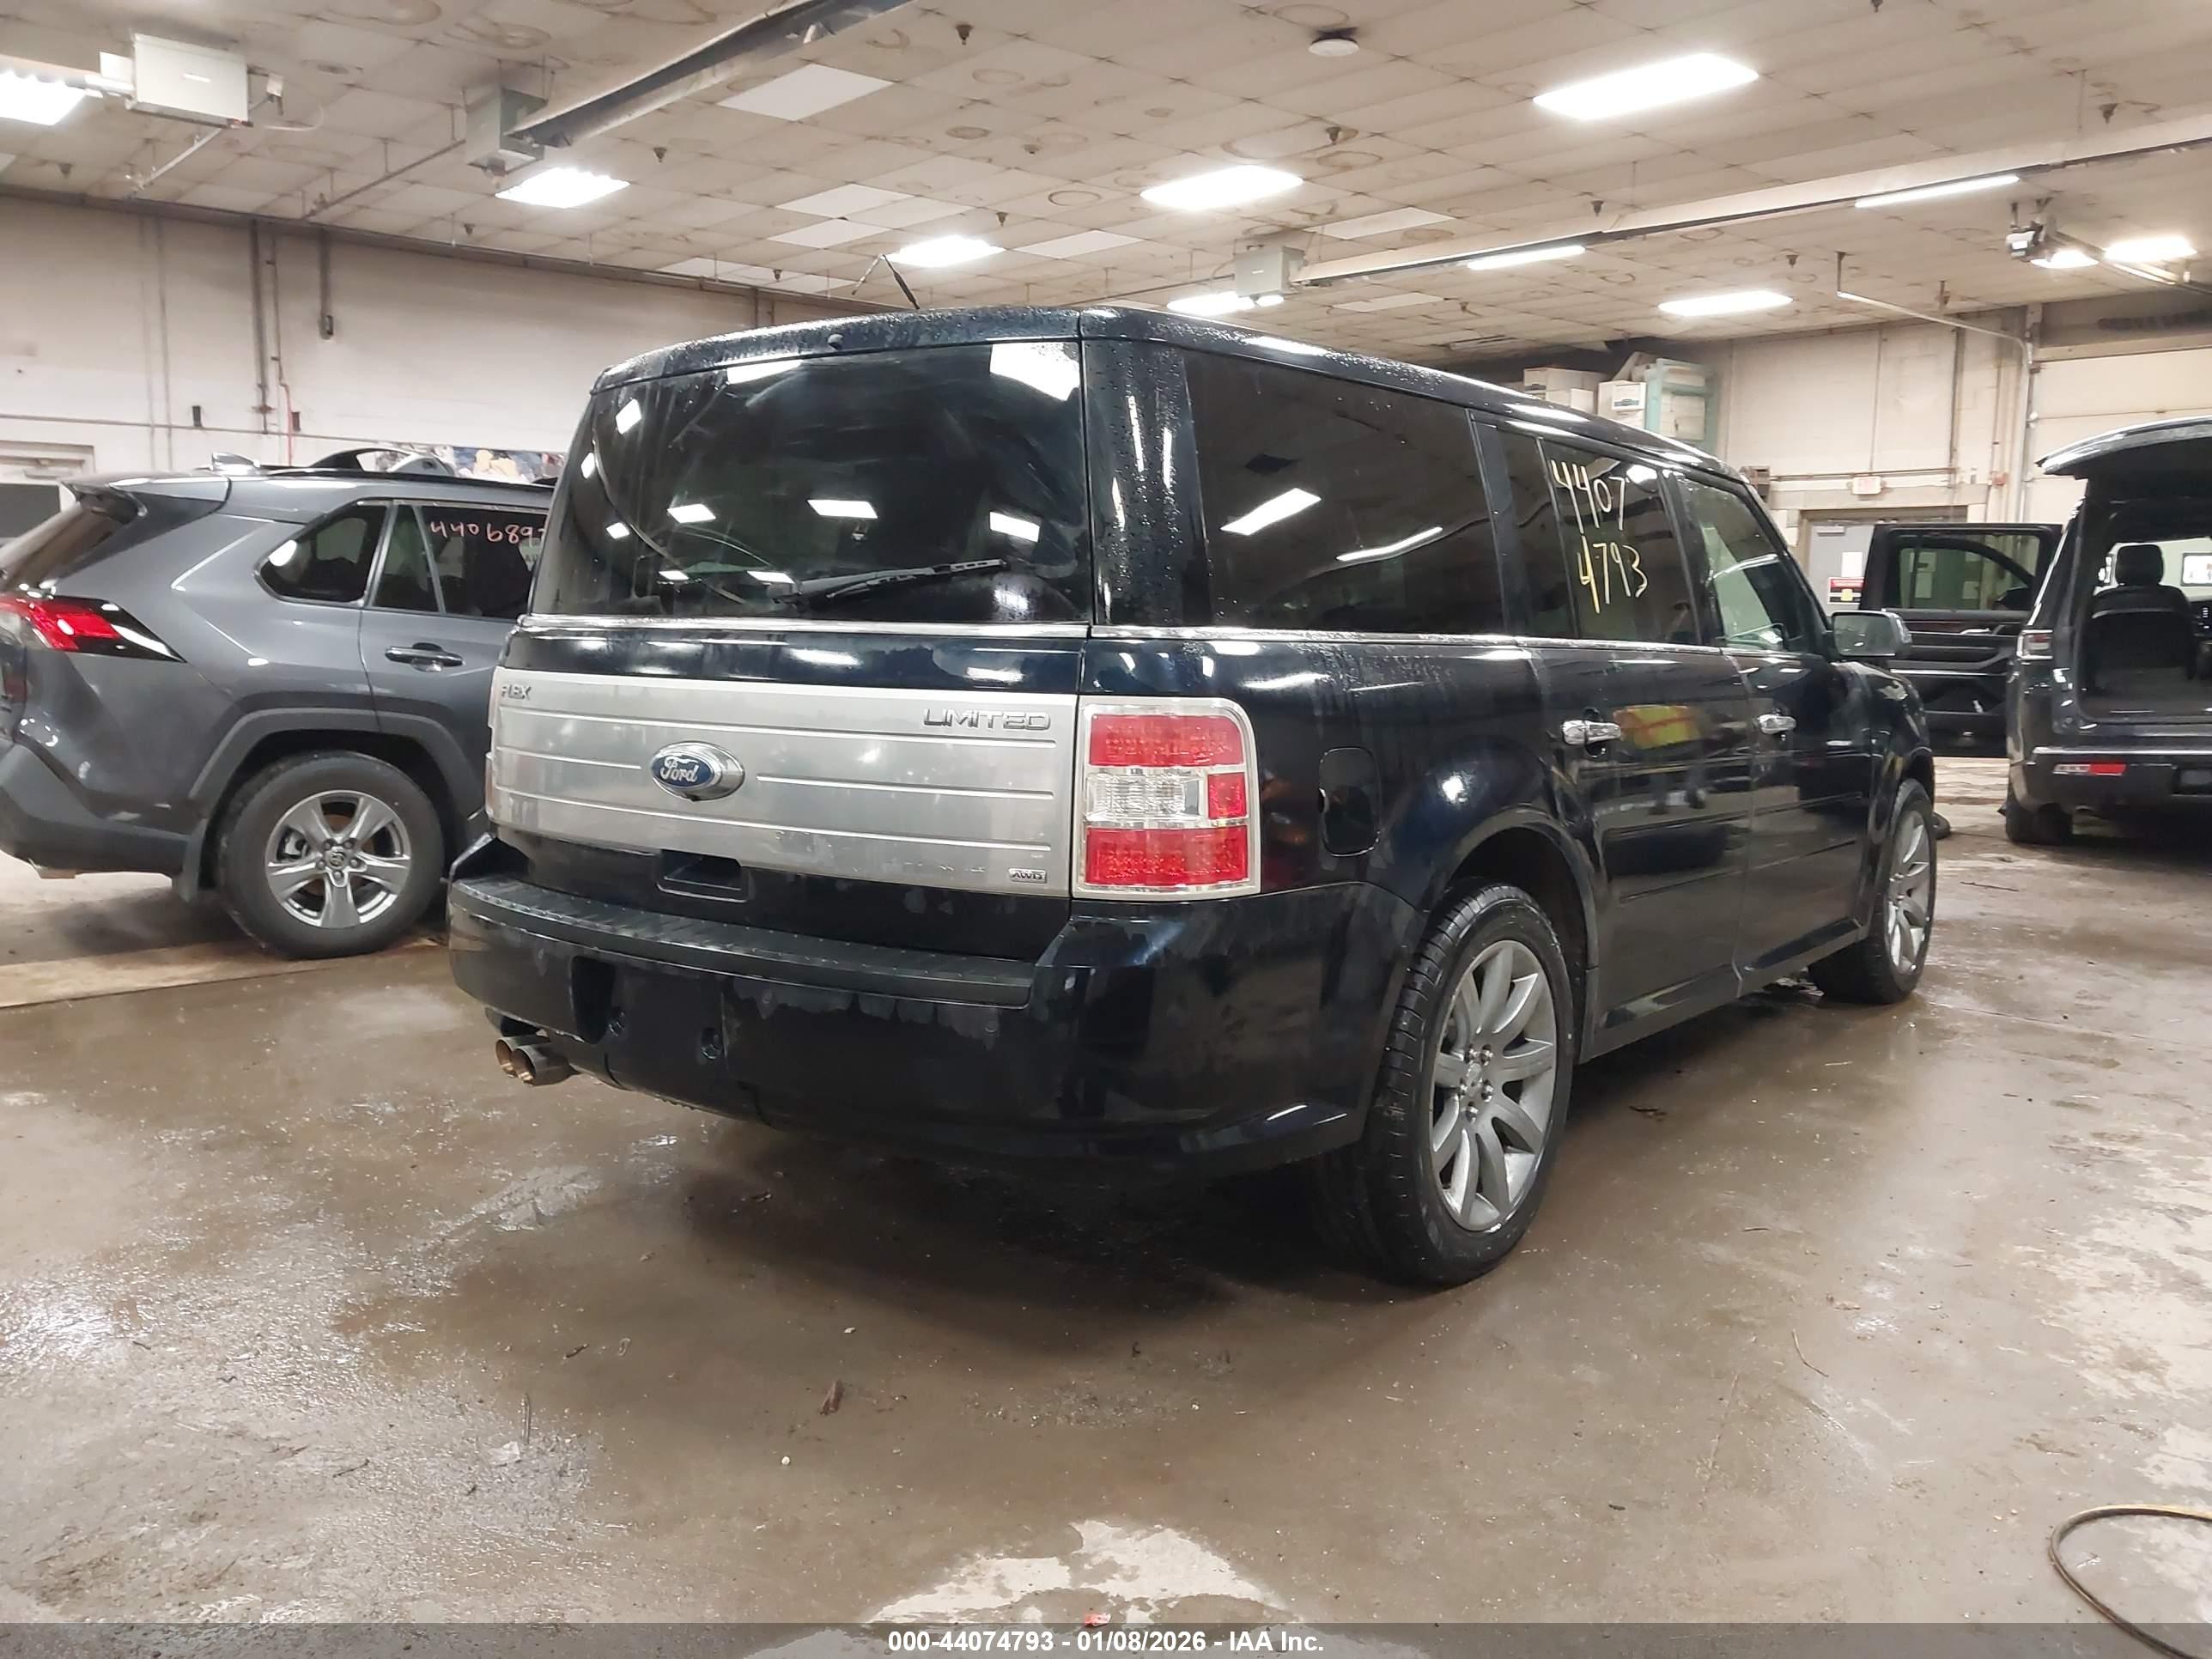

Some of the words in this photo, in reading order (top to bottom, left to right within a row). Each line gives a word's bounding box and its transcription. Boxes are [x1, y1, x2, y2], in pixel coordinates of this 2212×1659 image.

[1550, 459, 1627, 534] 4407
[1577, 535, 1648, 614] 4793
[501, 684, 532, 701] FLEX
[924, 708, 1051, 731] LIMITED
[659, 756, 700, 782] Ford
[1011, 870, 1044, 881] AWD
